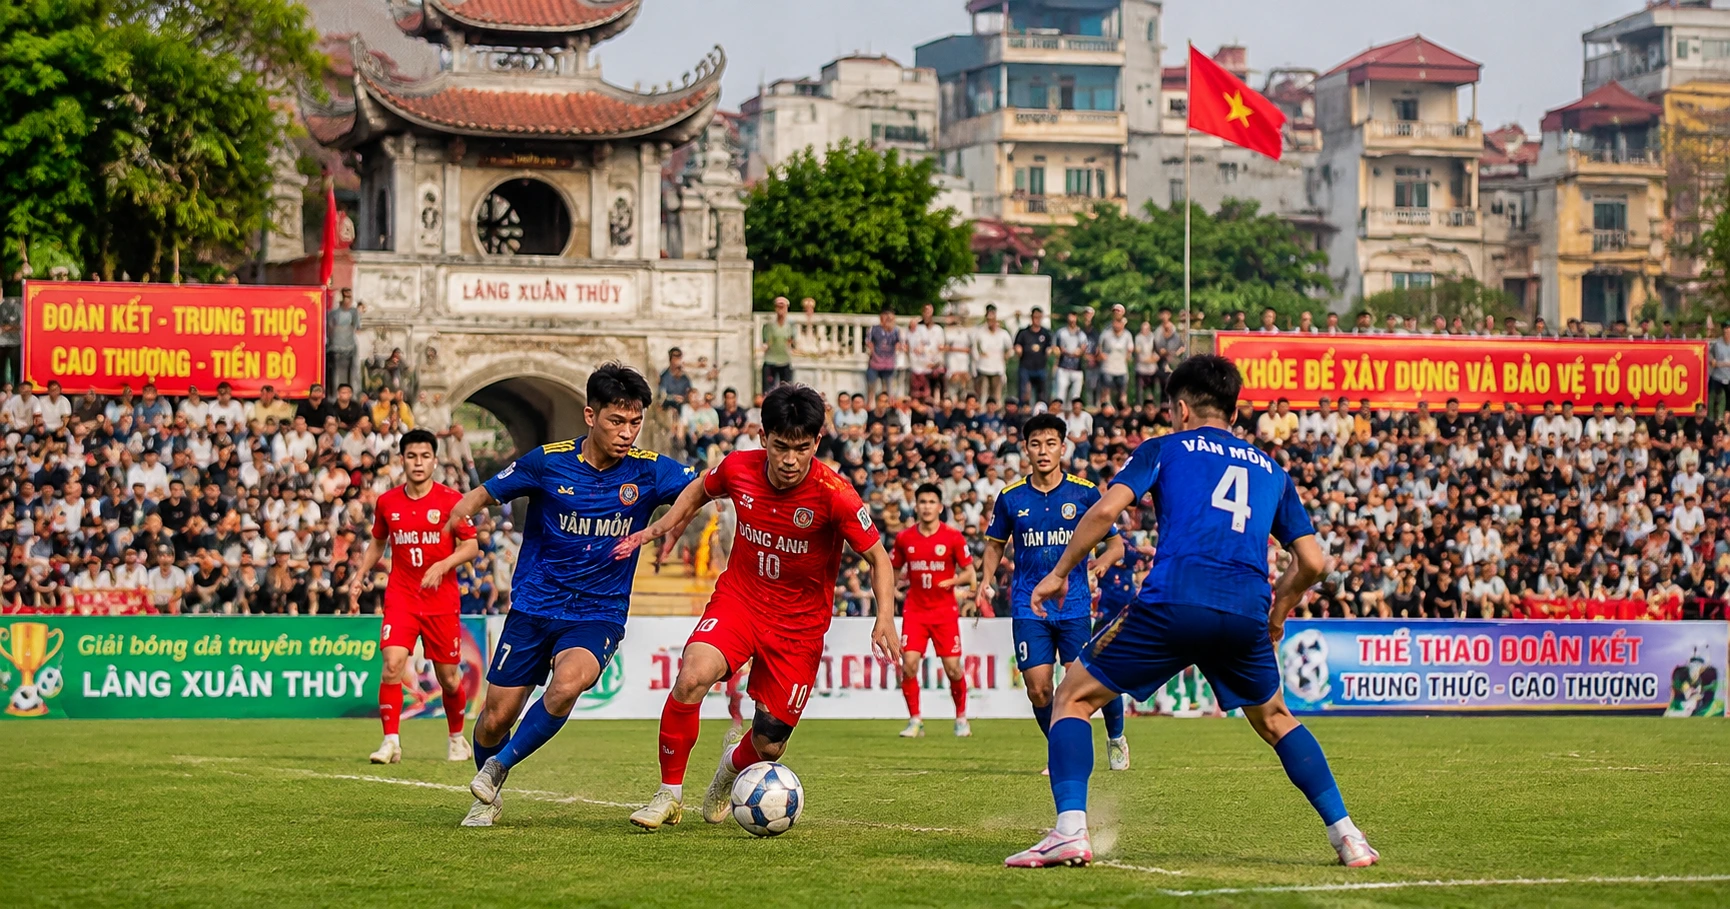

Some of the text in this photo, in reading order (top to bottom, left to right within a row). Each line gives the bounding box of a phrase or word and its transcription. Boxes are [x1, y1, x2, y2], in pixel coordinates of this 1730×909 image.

[157, 317, 168, 326] -
[171, 305, 246, 335] TRUNG
[251, 305, 307, 342] THỰC
[51, 346, 97, 376] CAO
[102, 346, 191, 384] THƯỢNG
[195, 361, 206, 370] -
[266, 345, 297, 387] BỘ
[1394, 357, 1460, 398] DỰNG
[1211, 464, 1251, 533] 4
[775, 535, 808, 554] ANH
[757, 550, 780, 580] 10
[129, 634, 188, 662] bóng
[497, 642, 511, 670] 7
[1019, 641, 1028, 661] 9
[1417, 636, 1491, 664] THAO
[1590, 629, 1642, 664] KẾT
[787, 683, 808, 708] 10
[1343, 675, 1418, 698] TRUNG
[1428, 673, 1488, 703] THỰC
[1511, 675, 1556, 698] CAO
